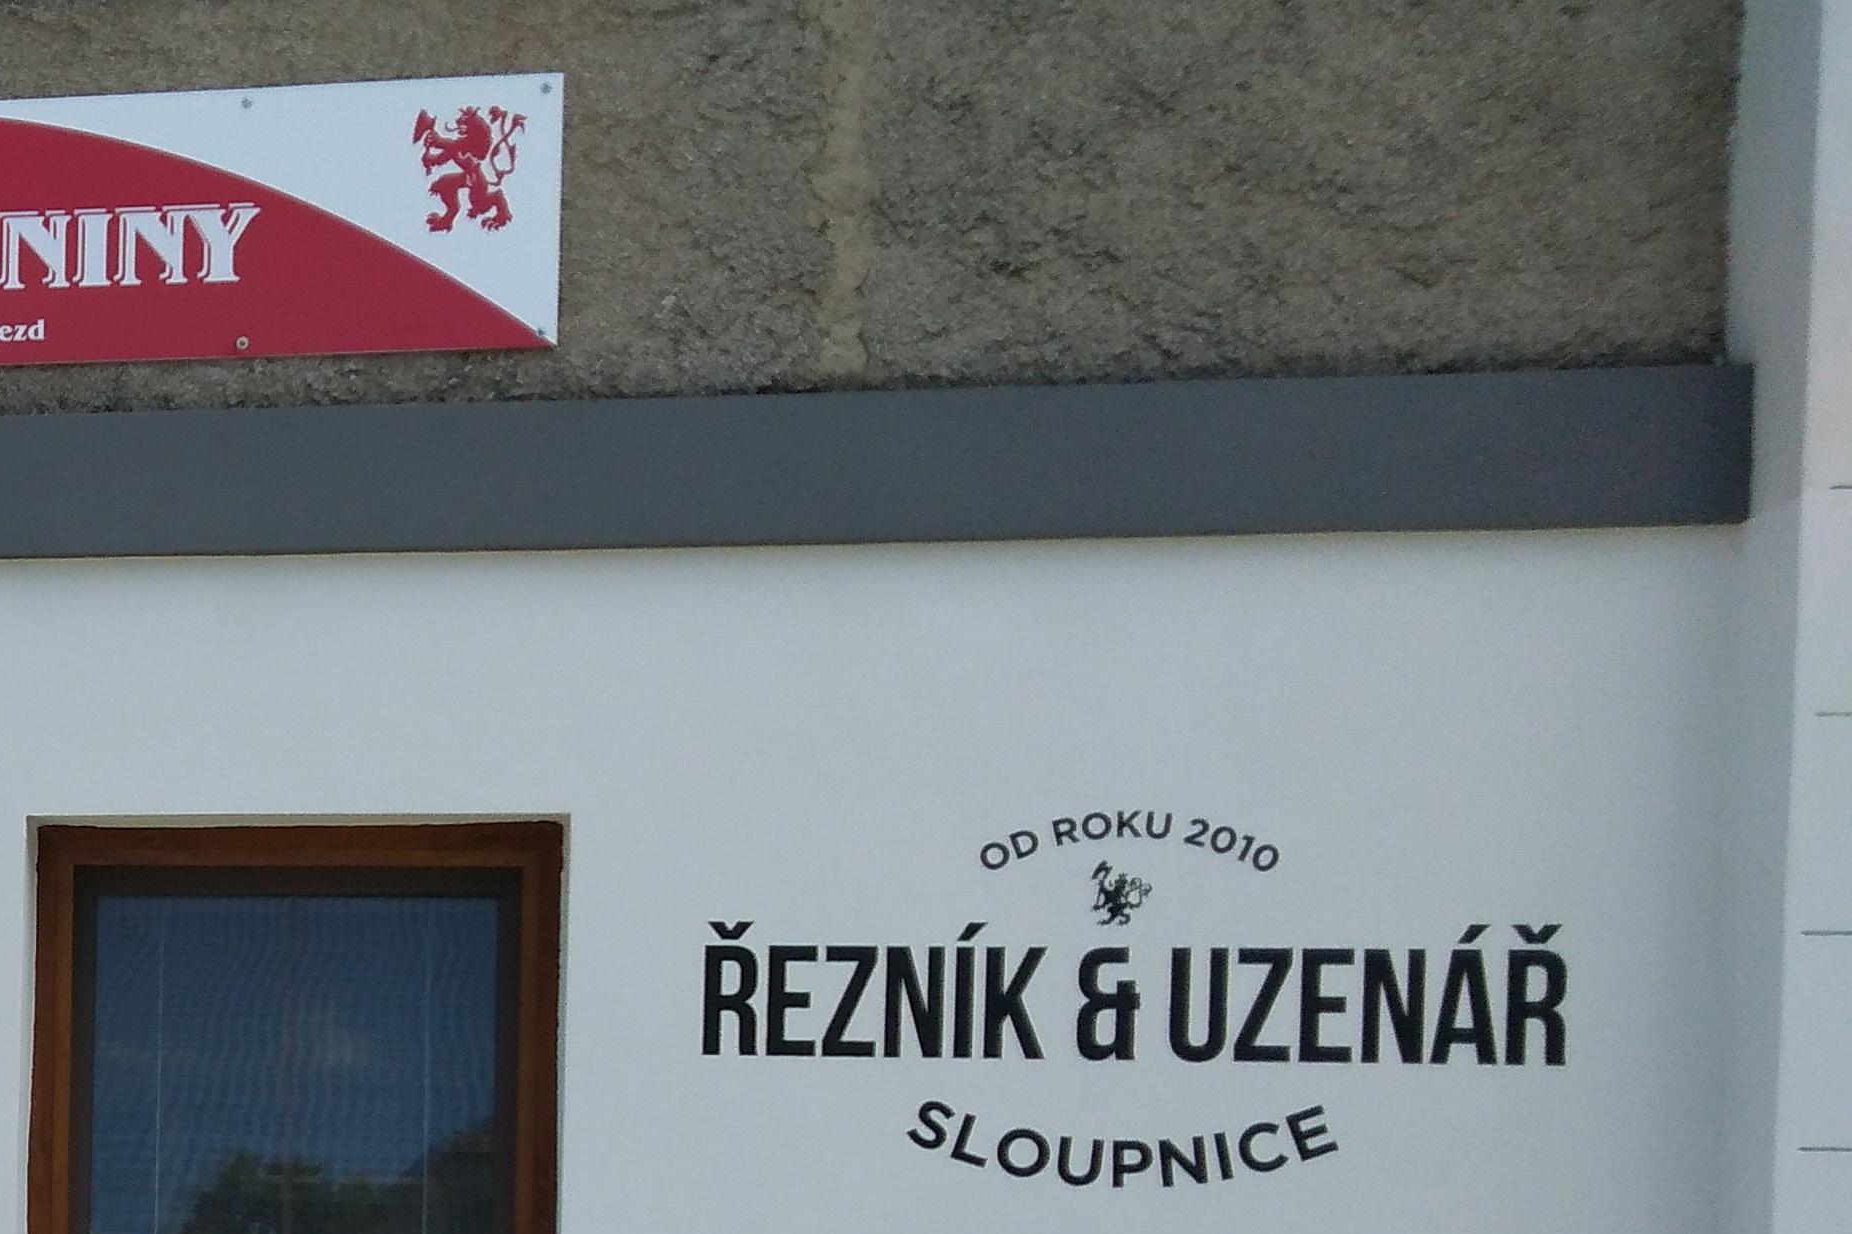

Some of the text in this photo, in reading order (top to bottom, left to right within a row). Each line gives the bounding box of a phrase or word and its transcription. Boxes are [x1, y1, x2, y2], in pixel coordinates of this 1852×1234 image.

[979, 809, 1281, 873] OD ROKU 2010
[701, 920, 1568, 1067] ŘEZNÍK & UZENÁŘ
[906, 1100, 1340, 1190] SLOUPNICE
